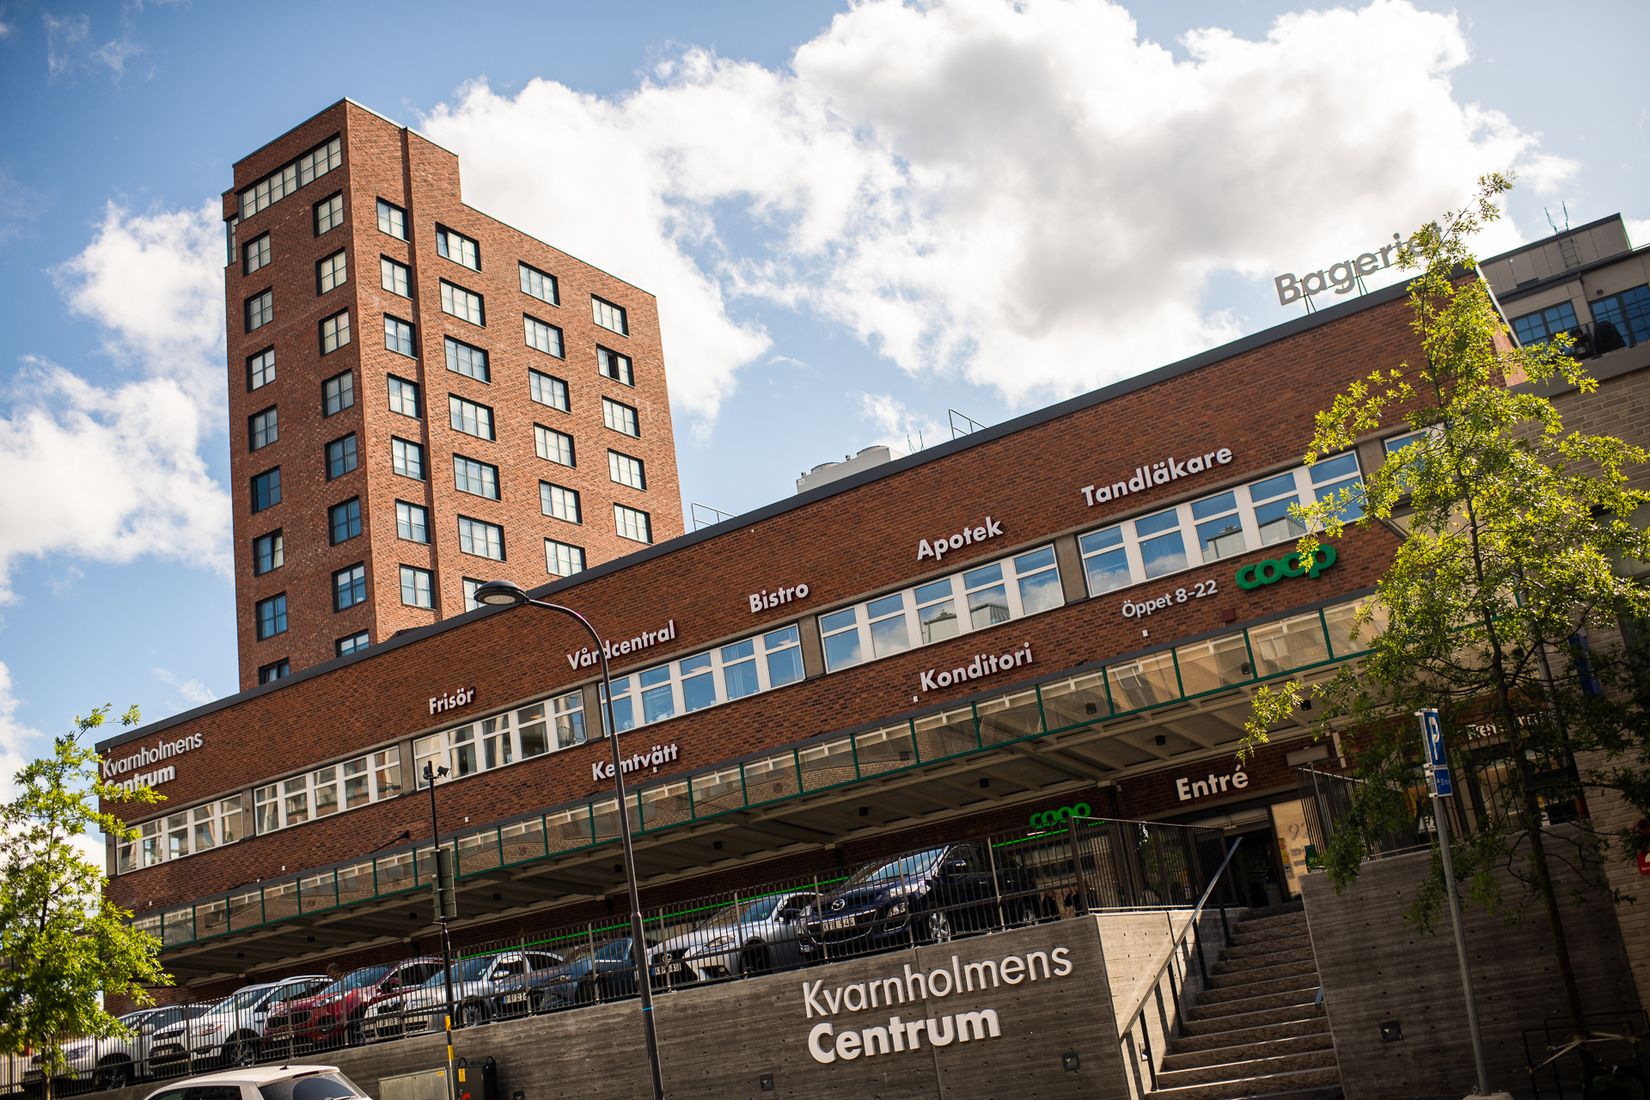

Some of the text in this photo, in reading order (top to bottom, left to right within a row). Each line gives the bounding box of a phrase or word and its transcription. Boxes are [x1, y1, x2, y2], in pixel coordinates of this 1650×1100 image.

[1081, 447, 1233, 507] Tandläkare
[917, 516, 1004, 561] Apotek
[1235, 543, 1337, 591] coop
[749, 583, 809, 614] Bistro
[1121, 579, 1219, 618] Öppet 8-22
[566, 619, 676, 671] Vårdcentral
[920, 641, 1033, 692] Konditori
[429, 687, 474, 715] Frisör
[103, 732, 204, 779] Kvarnholmens
[591, 743, 678, 781] Kemtvätt
[1175, 763, 1249, 801] Entré
[1029, 802, 1092, 829] coop
[802, 947, 1074, 1019] Kvarnholmens
[807, 1008, 1002, 1064] Centrum
